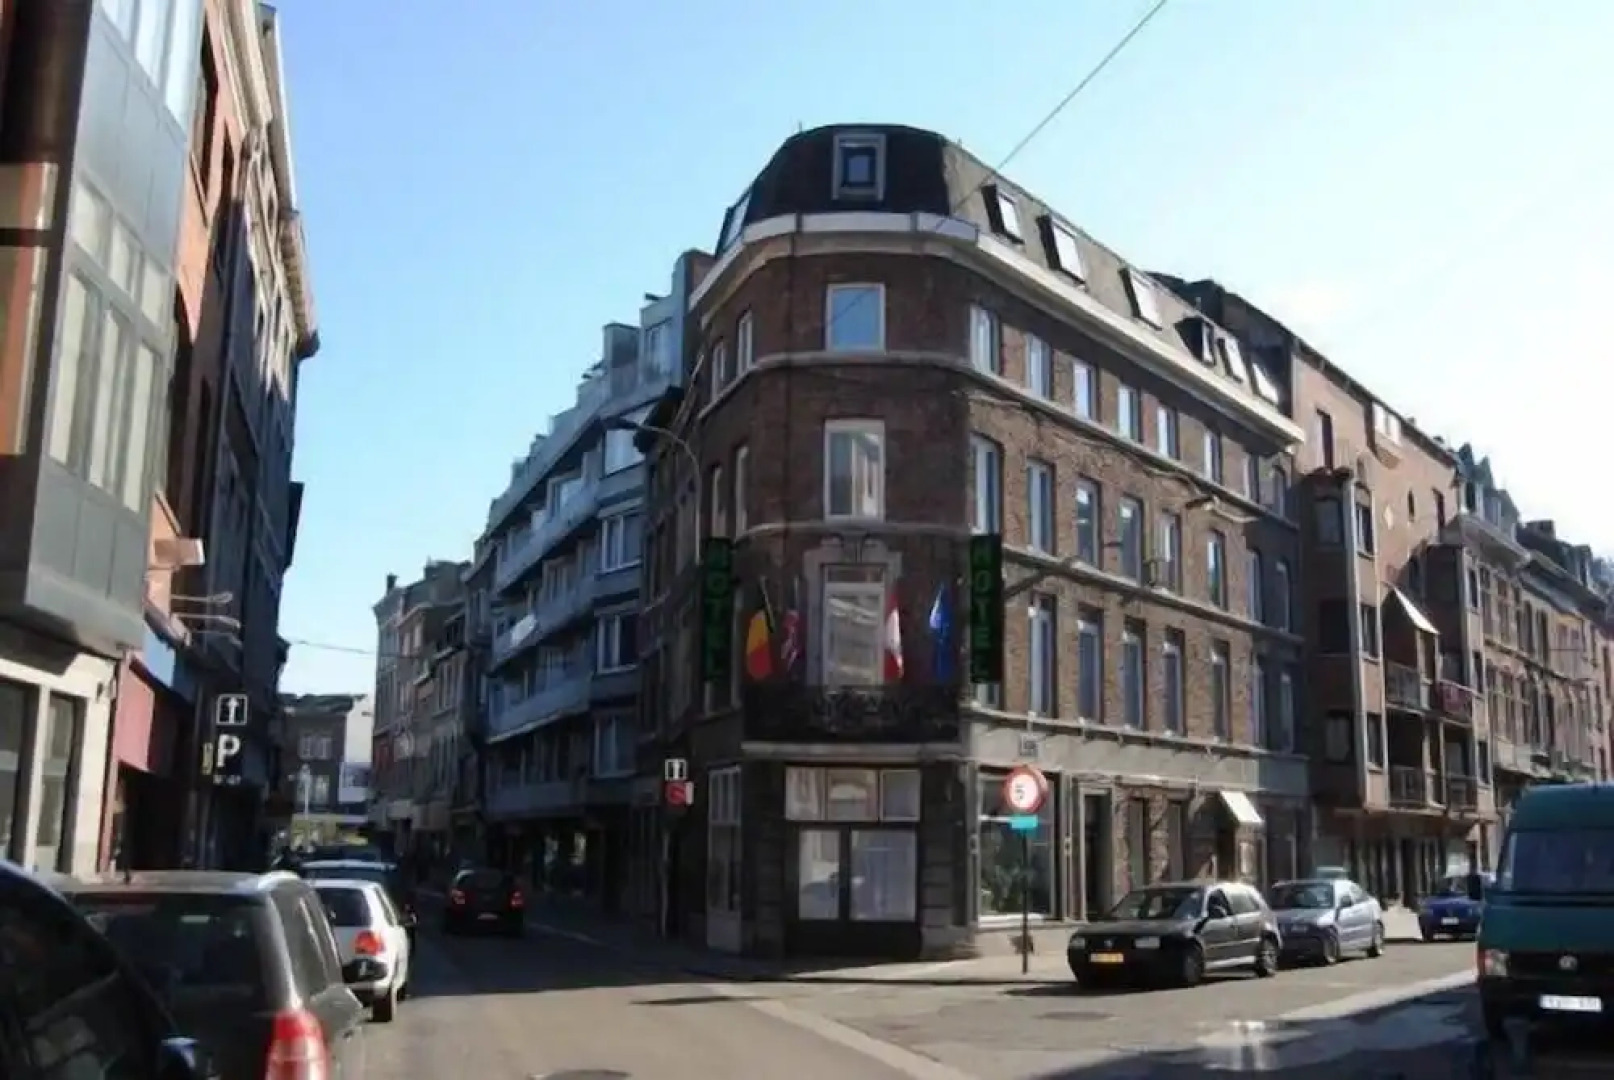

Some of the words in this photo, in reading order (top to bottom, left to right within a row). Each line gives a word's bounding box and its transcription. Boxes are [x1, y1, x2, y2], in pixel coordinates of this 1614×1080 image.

[704, 541, 728, 676] HOTEL
[973, 541, 992, 676] HOTEL
[217, 733, 241, 768] P
